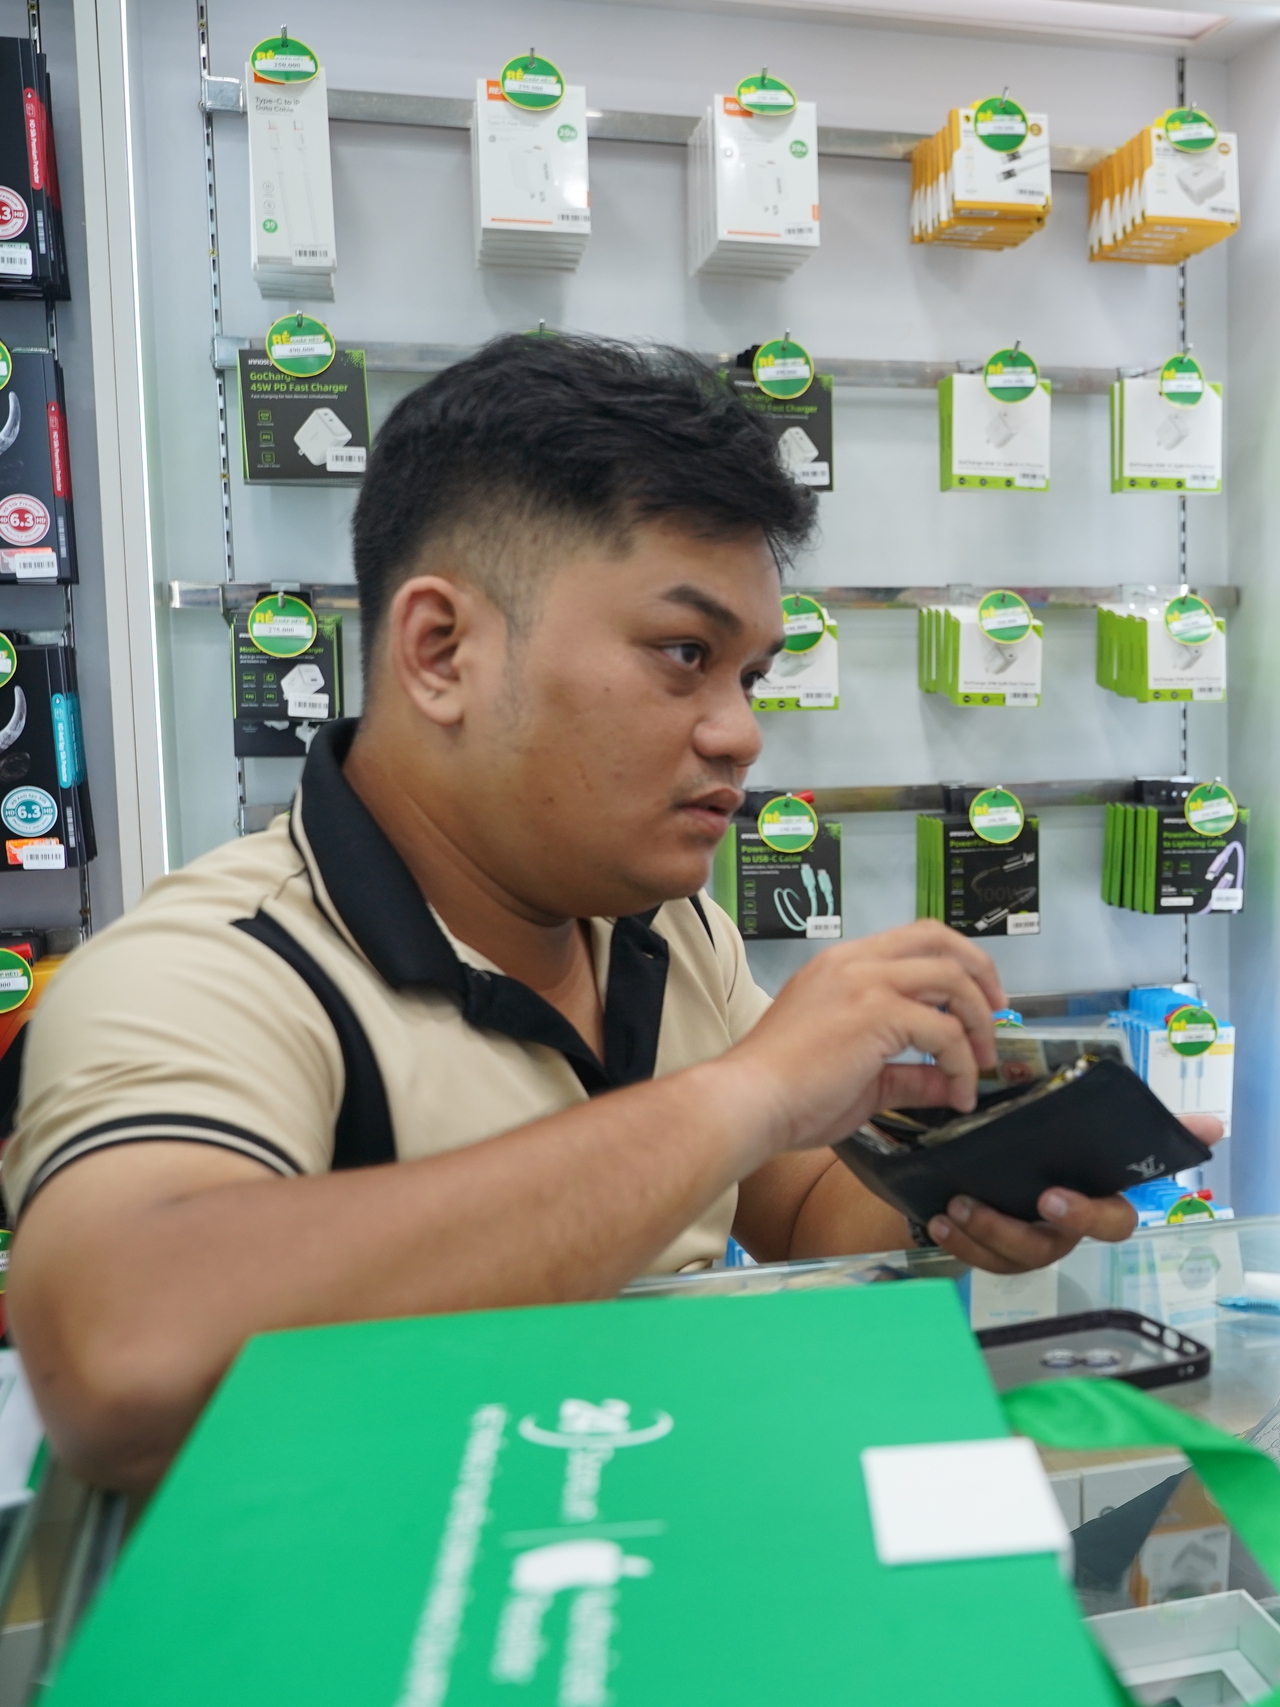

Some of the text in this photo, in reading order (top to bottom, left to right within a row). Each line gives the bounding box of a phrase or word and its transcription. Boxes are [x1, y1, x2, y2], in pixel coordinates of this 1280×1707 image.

[250, 383, 348, 394] 45W PD Fast Charger
[10, 513, 34, 527] 6.3
[17, 805, 41, 819] 6.3
